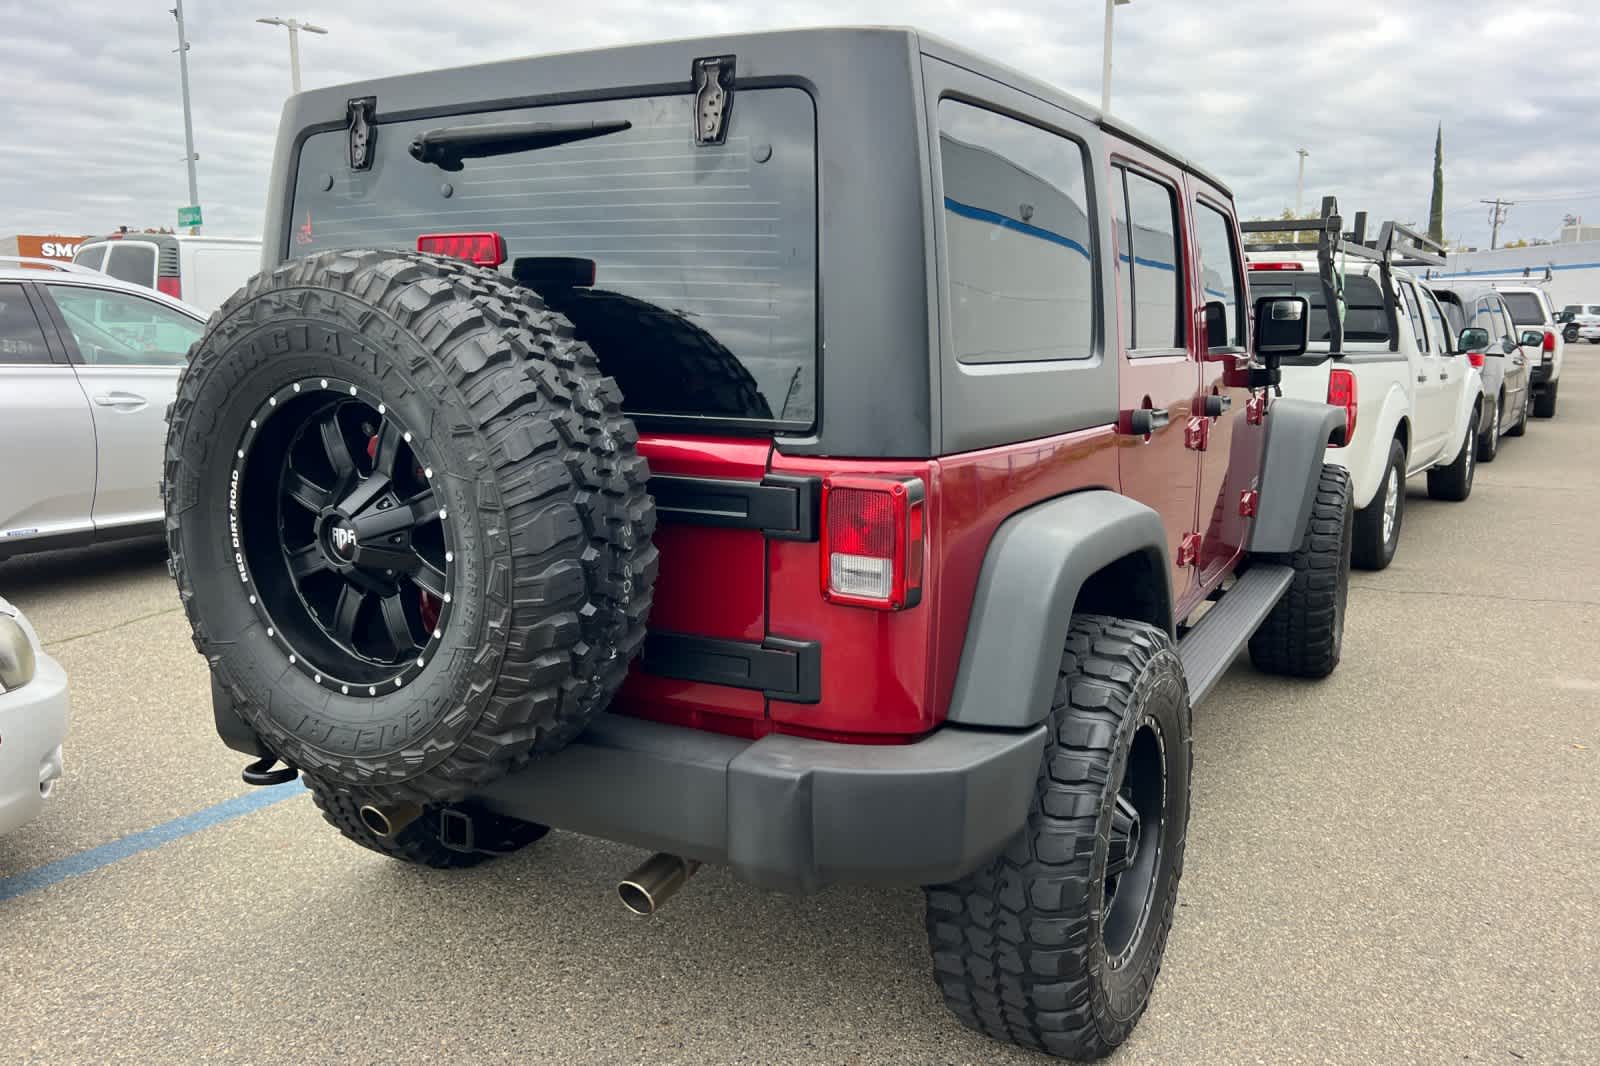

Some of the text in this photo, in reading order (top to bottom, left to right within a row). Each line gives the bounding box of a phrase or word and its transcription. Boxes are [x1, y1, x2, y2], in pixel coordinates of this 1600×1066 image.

[229, 469, 249, 582] RED DIRT ROAD
